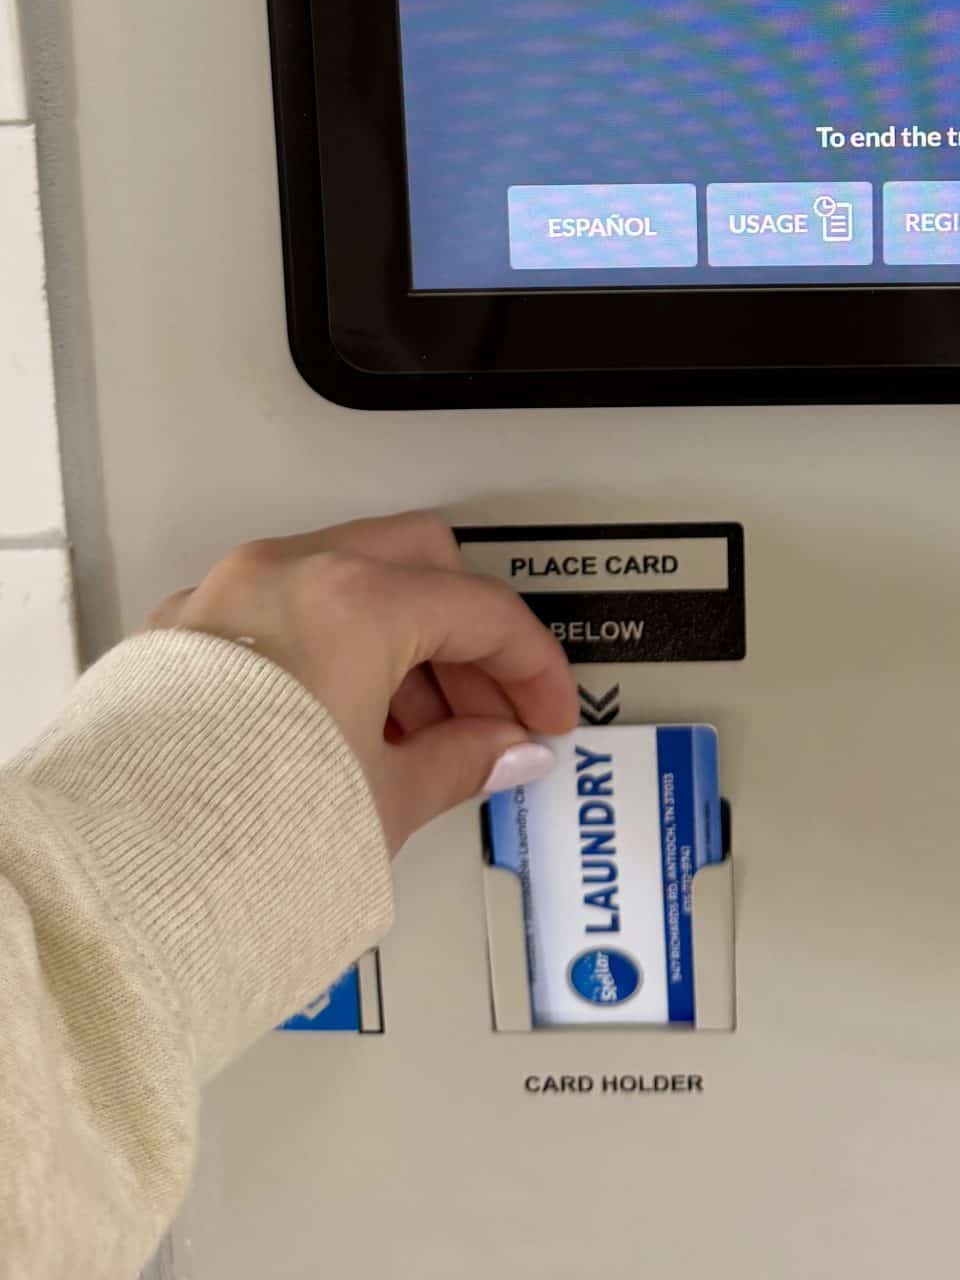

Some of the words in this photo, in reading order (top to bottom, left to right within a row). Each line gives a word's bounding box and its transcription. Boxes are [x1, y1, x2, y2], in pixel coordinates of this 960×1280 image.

[816, 126, 846, 149] To
[850, 125, 896, 149] end
[901, 124, 942, 148] the
[547, 212, 658, 240] ESPAÑOL
[728, 211, 808, 236] USAGE
[511, 556, 597, 577] PLACE
[605, 554, 679, 575] CARD
[550, 621, 644, 641] BELOW
[574, 746, 621, 935] LAUNDRY
[525, 1075, 594, 1094] CARD
[602, 1074, 704, 1093] HOLDER
